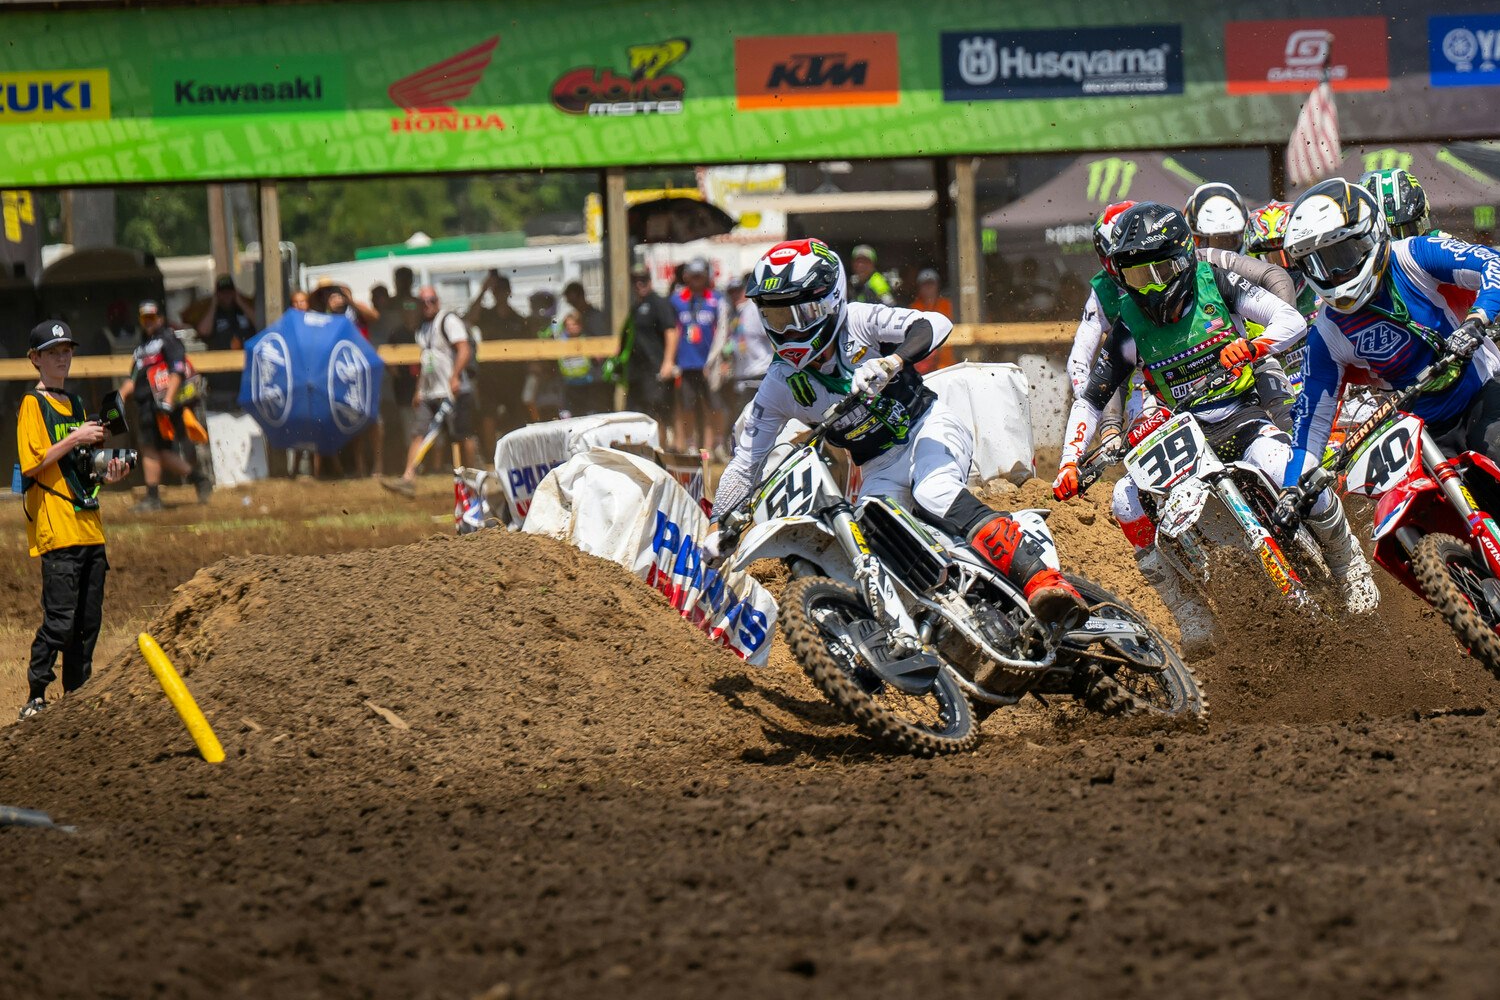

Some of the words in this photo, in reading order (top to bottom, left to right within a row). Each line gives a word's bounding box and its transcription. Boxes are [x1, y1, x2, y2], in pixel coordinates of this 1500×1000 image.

[767, 52, 870, 89] KTM
[1001, 46, 1167, 82] Husqvarna
[0, 80, 92, 112] UKI
[173, 76, 323, 106] Kawasaki
[390, 112, 506, 133] HONDA
[1187, 353, 1215, 369] MONSTER
[1137, 425, 1198, 488] 39
[1365, 427, 1414, 496] 40
